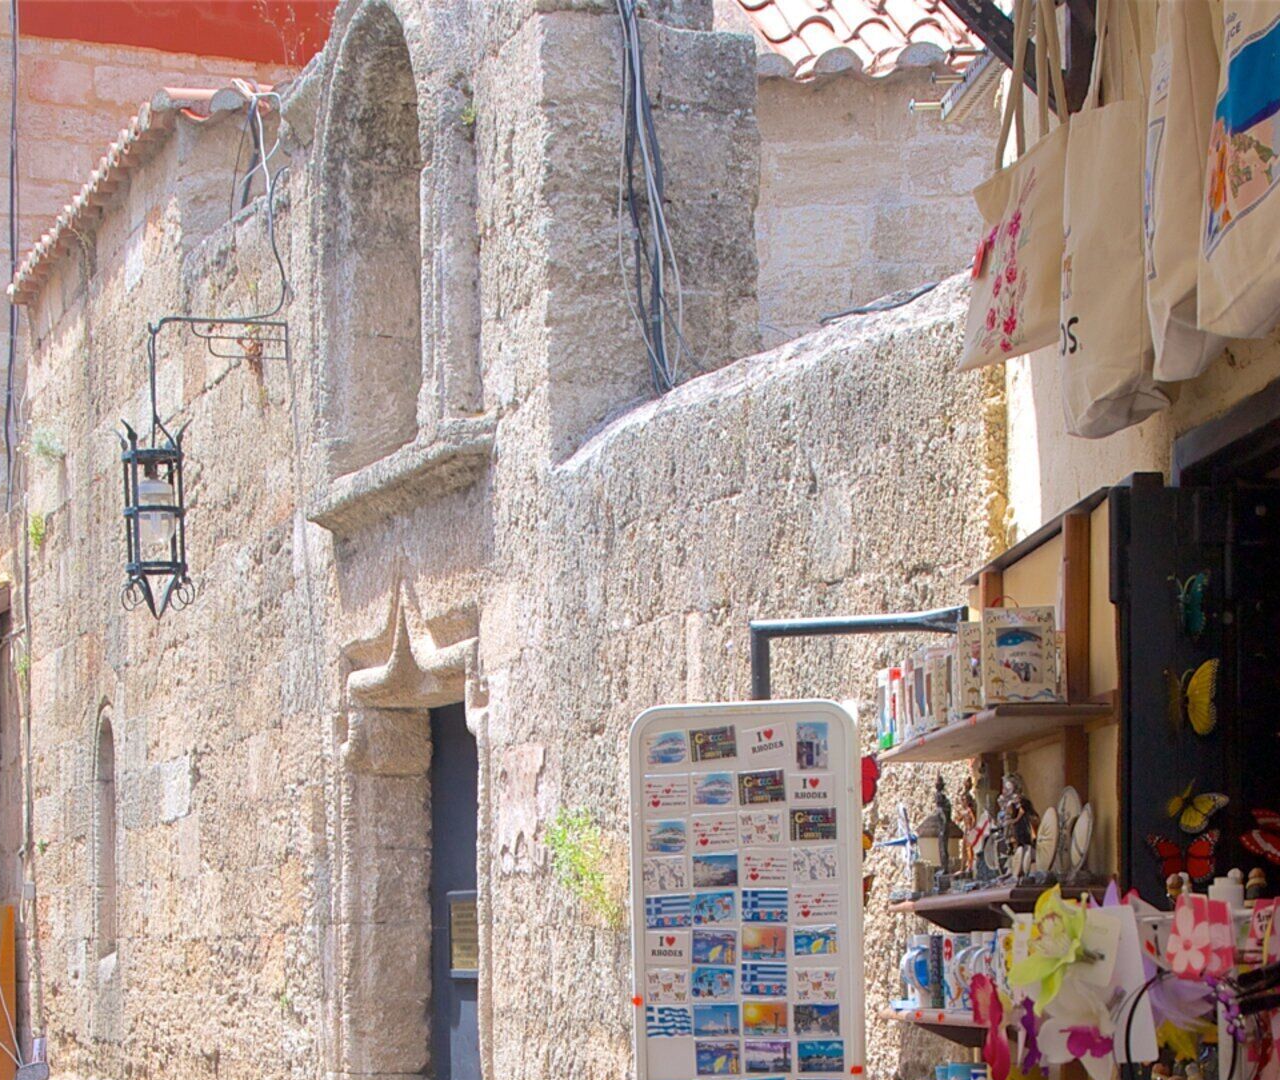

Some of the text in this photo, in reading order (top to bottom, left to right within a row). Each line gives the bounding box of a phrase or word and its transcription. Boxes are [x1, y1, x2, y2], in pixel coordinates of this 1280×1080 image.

[751, 740, 784, 754] RHODES
[794, 791, 828, 800] RHODES
[651, 949, 683, 957] RHODES
